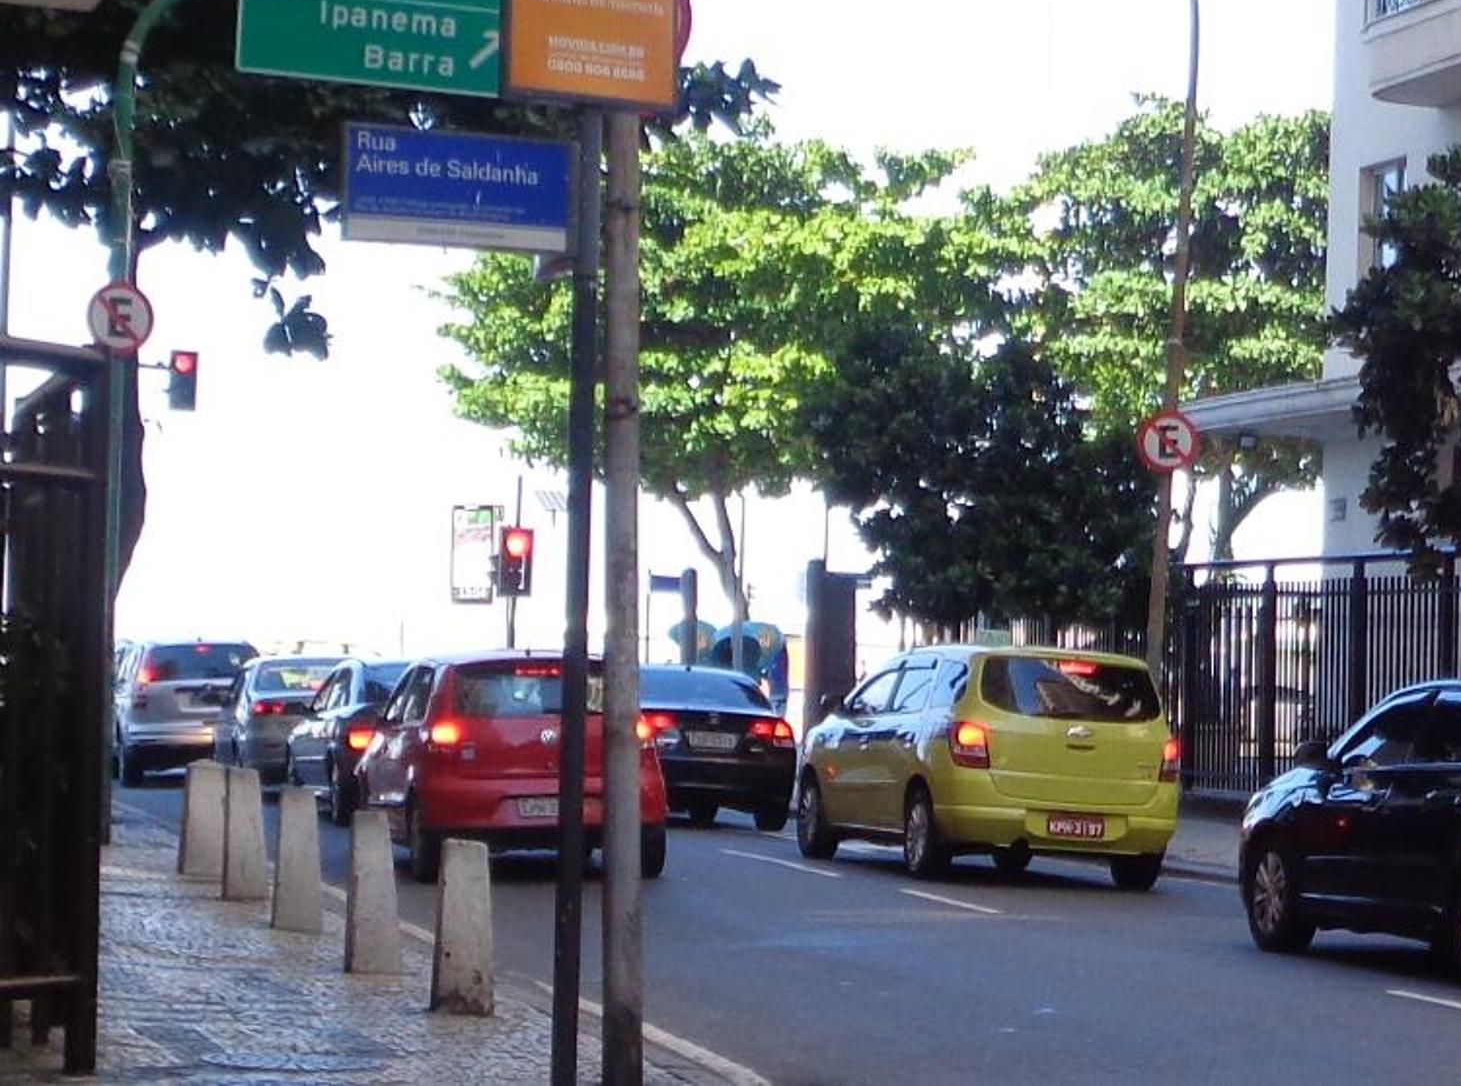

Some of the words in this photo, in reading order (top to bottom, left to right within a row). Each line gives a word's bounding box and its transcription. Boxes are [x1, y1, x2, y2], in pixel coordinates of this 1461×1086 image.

[319, 0, 457, 39] Ipanema
[363, 44, 455, 77] Barra
[357, 130, 397, 153] Rua
[355, 153, 410, 175] Aires
[414, 158, 441, 178] de
[447, 159, 540, 186] Saldanha
[108, 297, 133, 337] E
[1158, 424, 1179, 460] E
